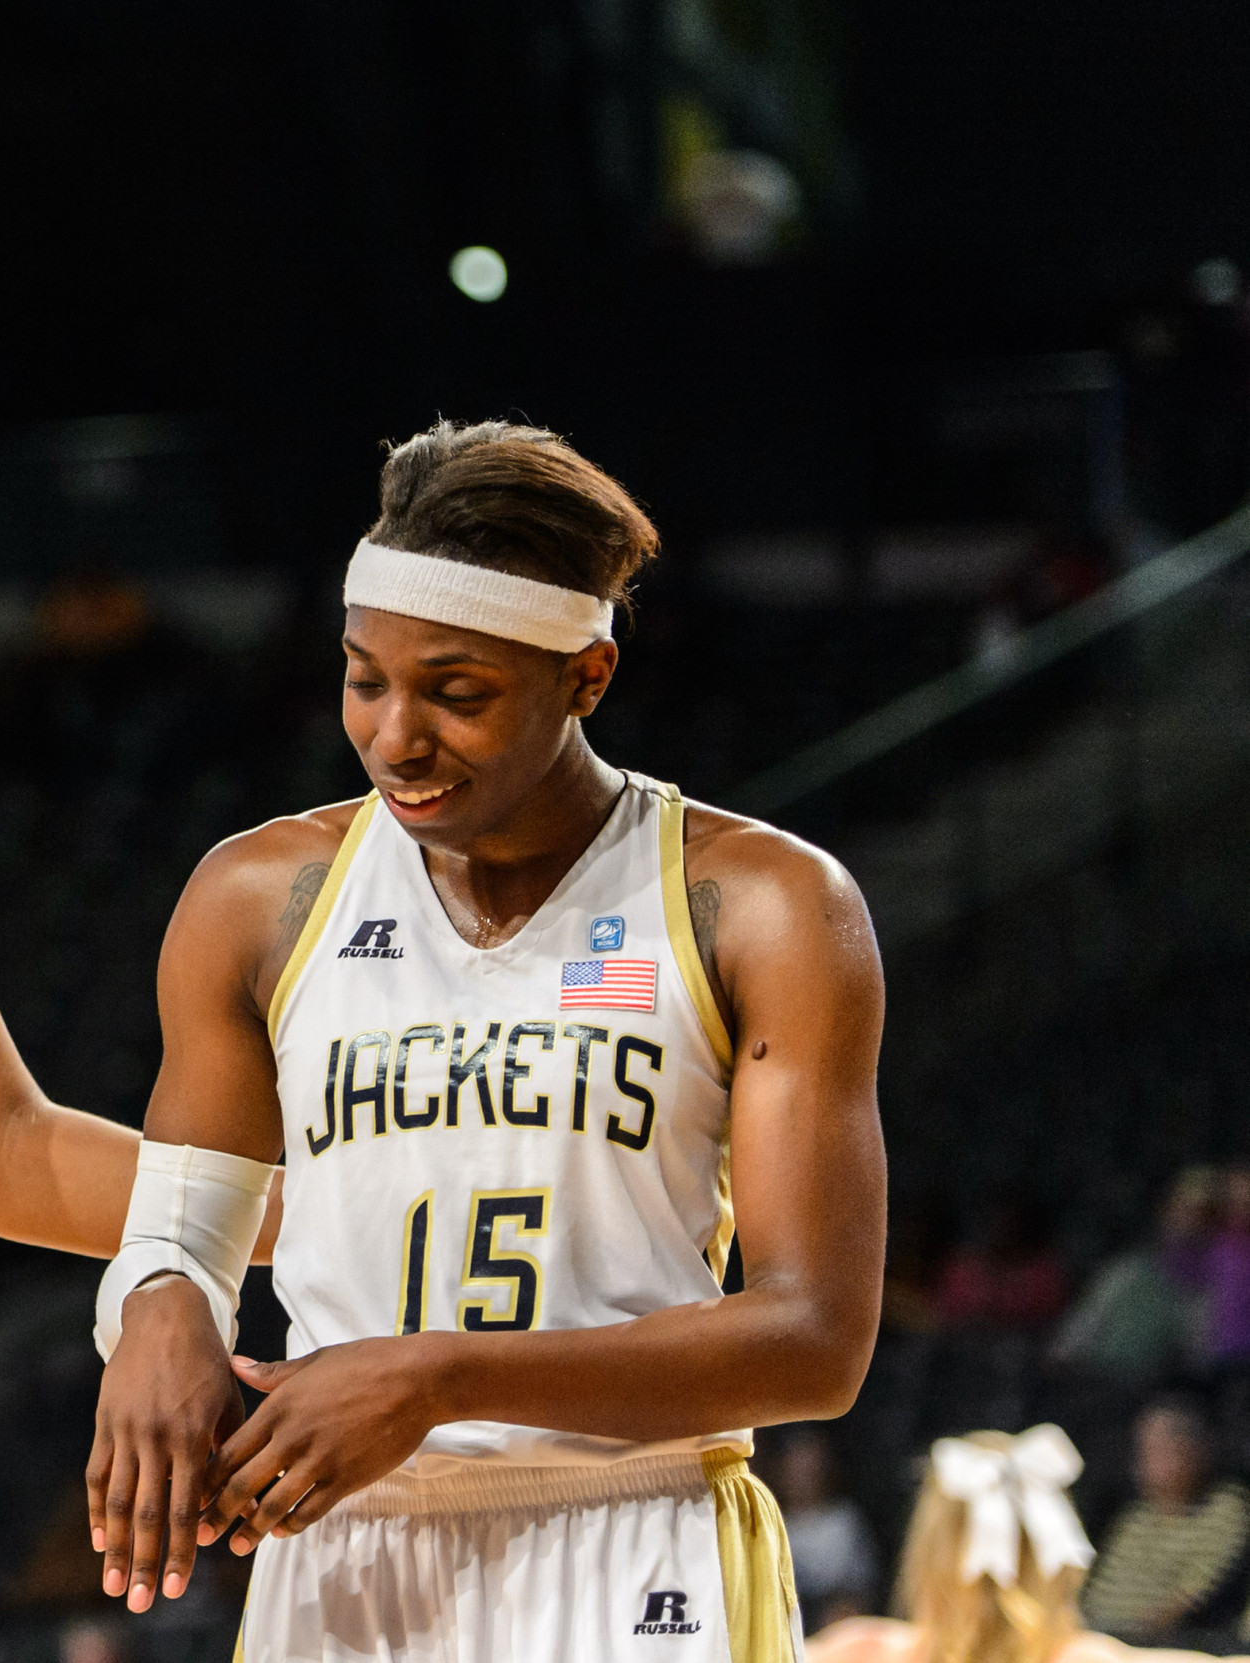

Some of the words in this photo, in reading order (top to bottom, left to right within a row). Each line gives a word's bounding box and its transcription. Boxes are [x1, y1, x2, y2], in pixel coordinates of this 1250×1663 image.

[337, 947, 404, 959] RUSSELL
[305, 1021, 664, 1158] JACKETS
[395, 1187, 552, 1336] 15
[633, 1620, 702, 1635] RUSSELL
